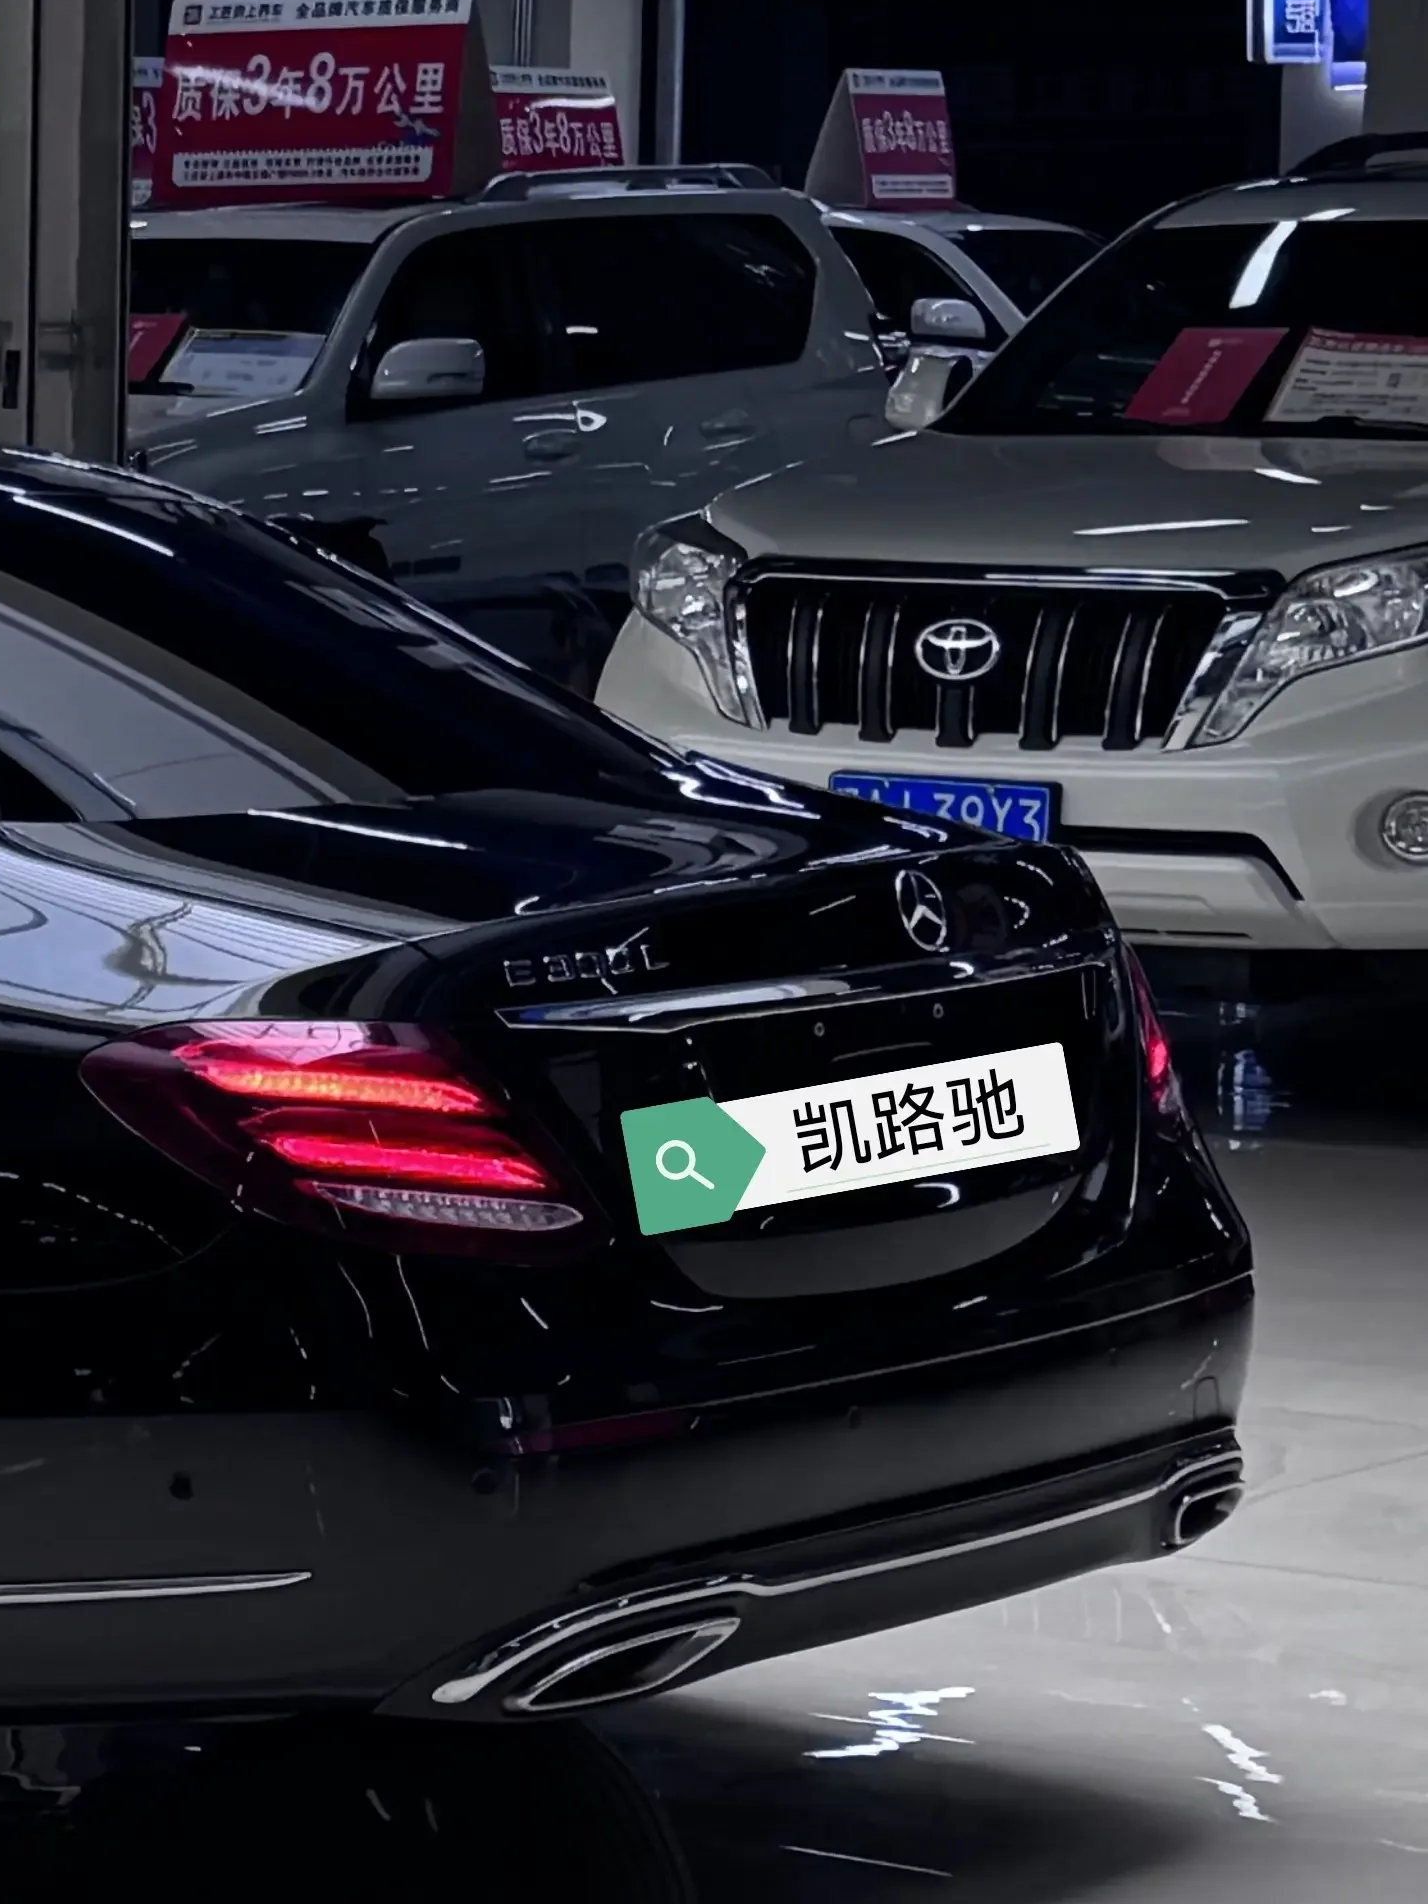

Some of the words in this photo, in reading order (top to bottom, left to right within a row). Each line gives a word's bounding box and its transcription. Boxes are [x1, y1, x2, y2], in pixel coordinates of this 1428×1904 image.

[171, 52, 445, 121] 质保3年8万公里
[499, 110, 619, 158] 质保3年8万公里
